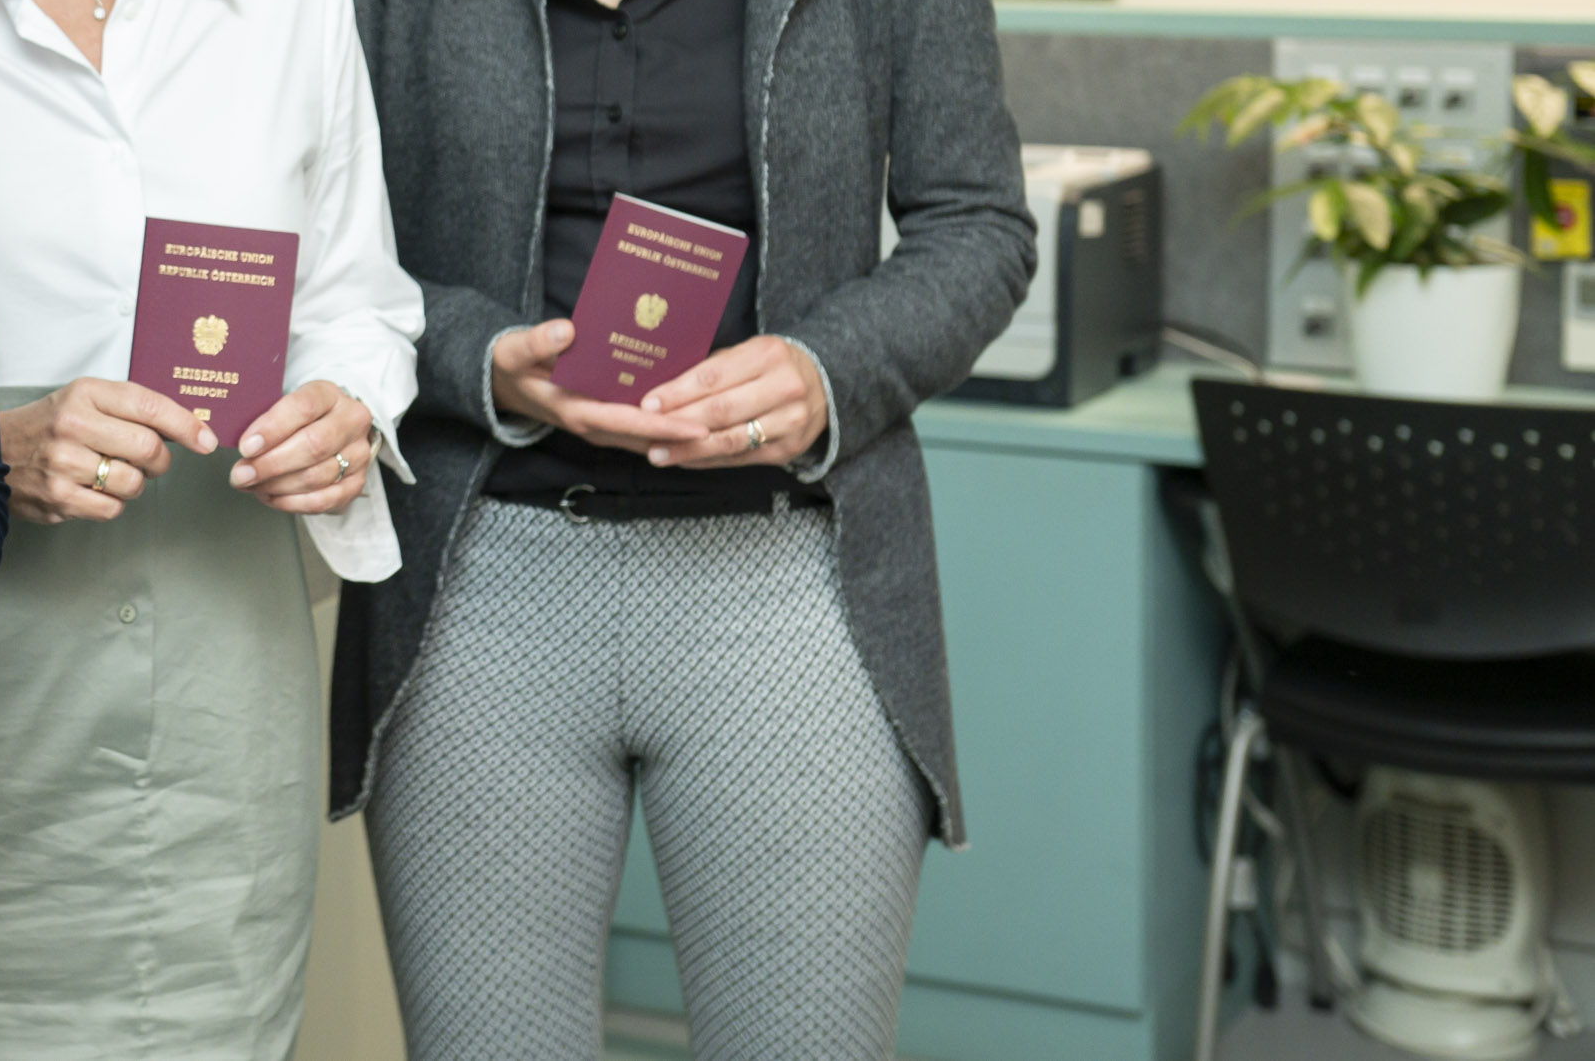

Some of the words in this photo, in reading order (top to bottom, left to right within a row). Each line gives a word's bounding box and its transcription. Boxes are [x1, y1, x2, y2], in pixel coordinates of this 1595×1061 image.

[164, 243, 239, 262] EUROPÄISCHE
[241, 252, 274, 265] UNION
[617, 240, 663, 263] REPUBLIK
[693, 242, 723, 262] UNION
[158, 264, 208, 280] REPUBLIK
[210, 269, 275, 287] ÖSTERREICH
[172, 366, 239, 385] REISEPASS
[179, 384, 228, 398] PASSPORT
